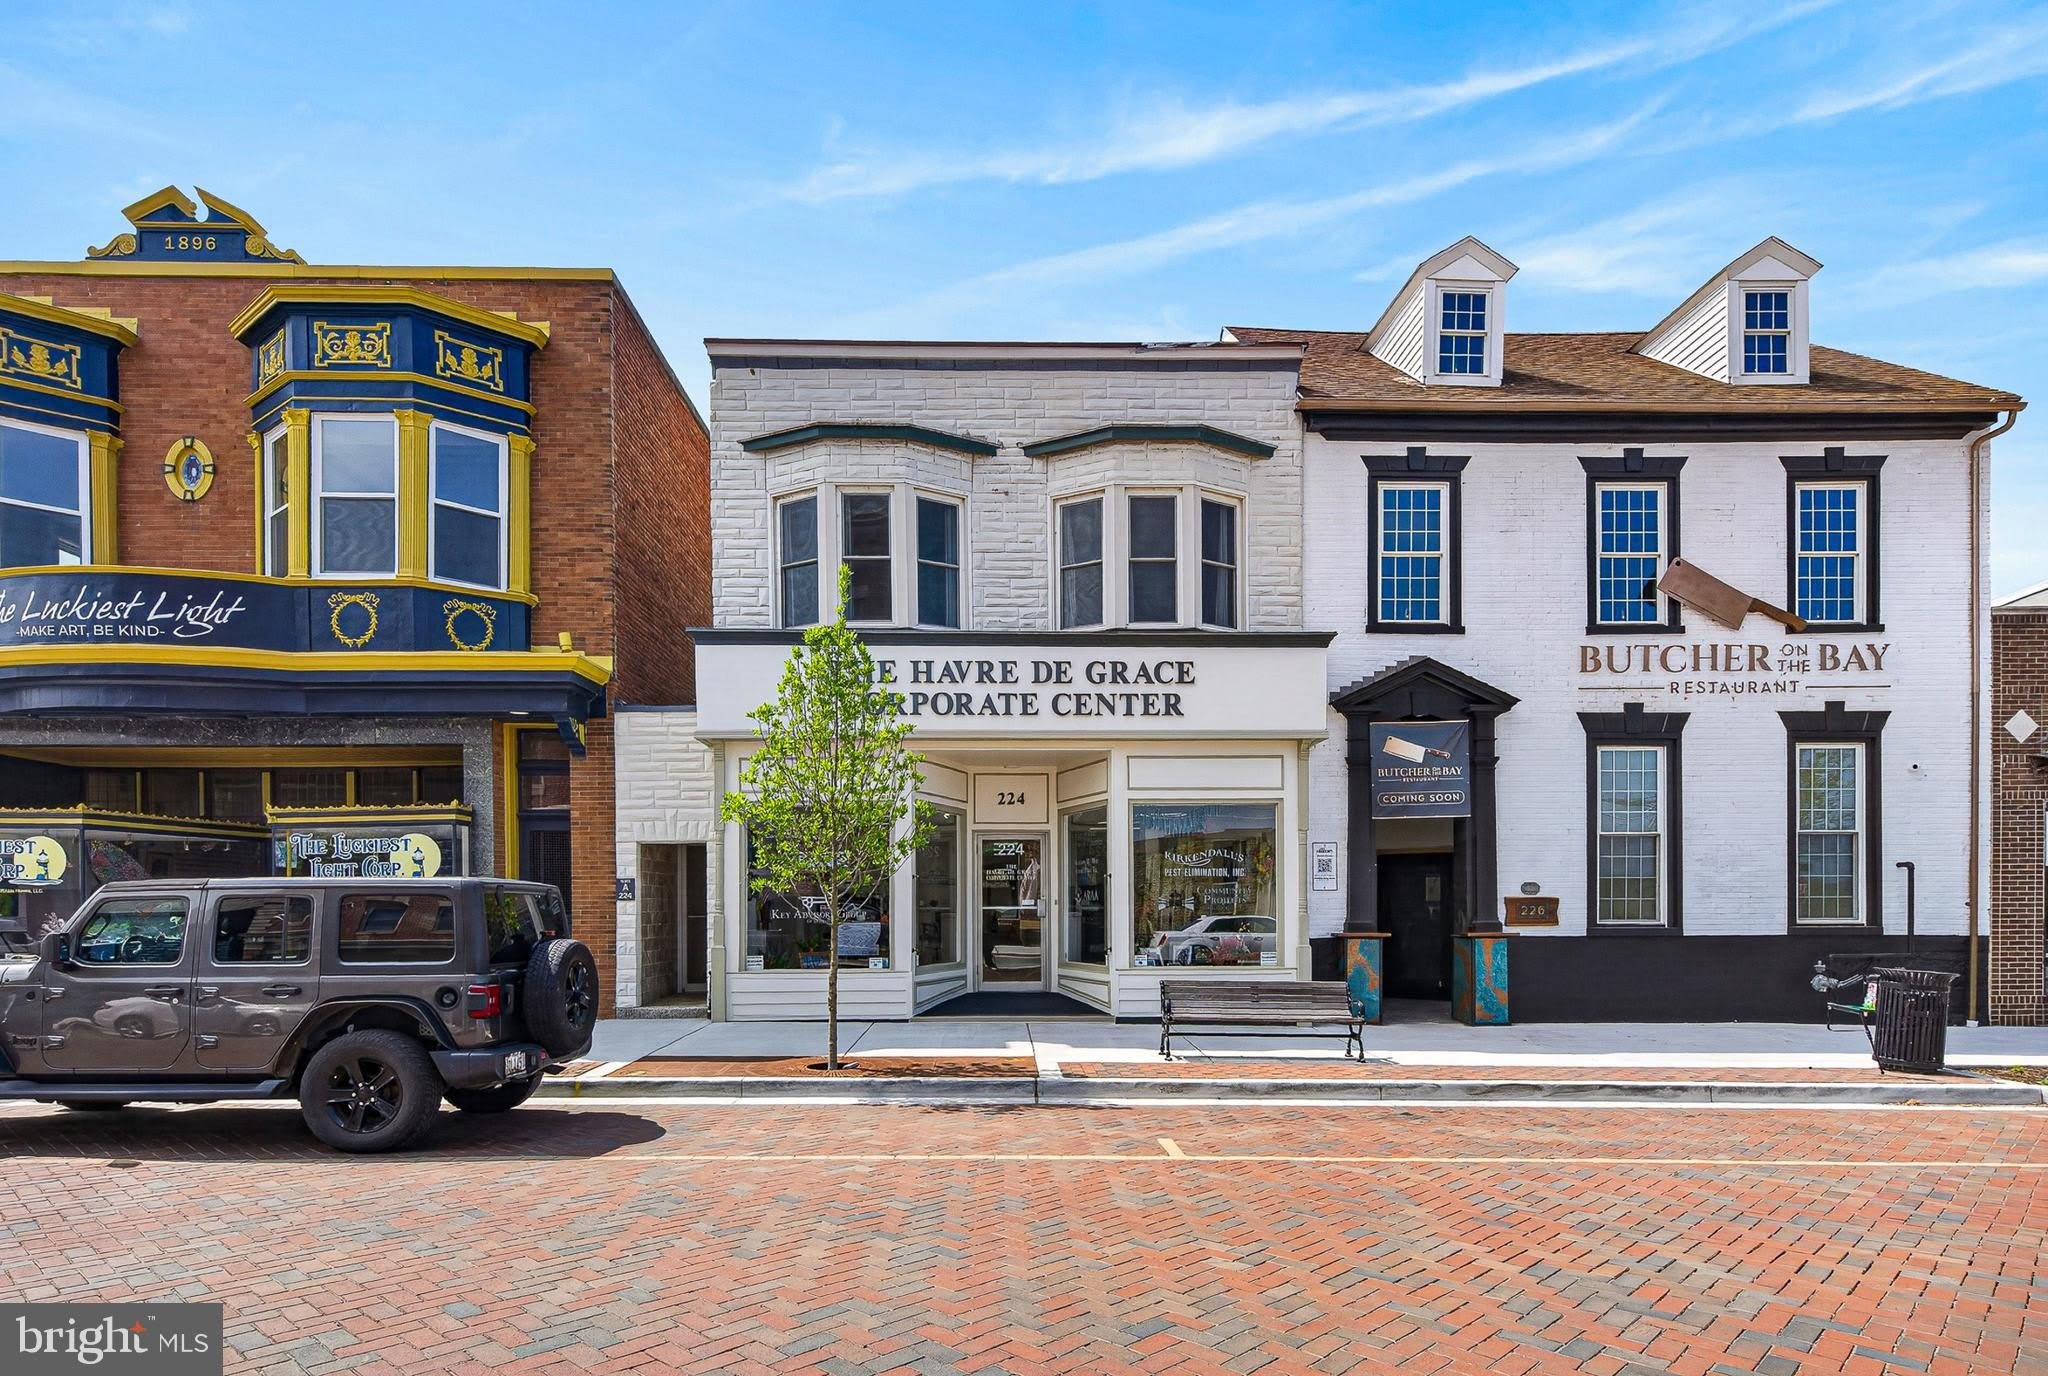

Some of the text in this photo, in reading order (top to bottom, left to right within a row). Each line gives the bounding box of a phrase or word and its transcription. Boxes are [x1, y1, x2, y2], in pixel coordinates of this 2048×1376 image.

[164, 236, 216, 250] 1896
[21, 585, 145, 621] Luckiest
[146, 590, 246, 638] Light
[58, 625, 90, 637] ART,
[93, 624, 114, 637] BE
[1578, 643, 1891, 674] BUTCHER ON THE BAY
[910, 660, 1019, 684] HAVRE
[1031, 660, 1073, 684] DE
[1085, 660, 1196, 685] GRACE
[1670, 680, 1800, 695] RESTAURANT
[863, 691, 1185, 717] ORPORATE CENTER
[1378, 767, 1431, 777] BUTCHER
[1442, 766, 1463, 775] BAY
[997, 792, 1025, 805] 224
[1382, 793, 1460, 804] COMING SOON
[290, 832, 411, 860] THE LUCKIEST
[998, 843, 1024, 856] 224
[1164, 848, 1244, 863] KIRKENDALL'S
[309, 856, 405, 877] LIGHT CORP.
[1165, 867, 1181, 877] PEST
[1184, 867, 1230, 878] ELIMINATION,
[622, 883, 629, 891] A
[771, 909, 791, 919] KEY
[1521, 905, 1545, 916] 226
